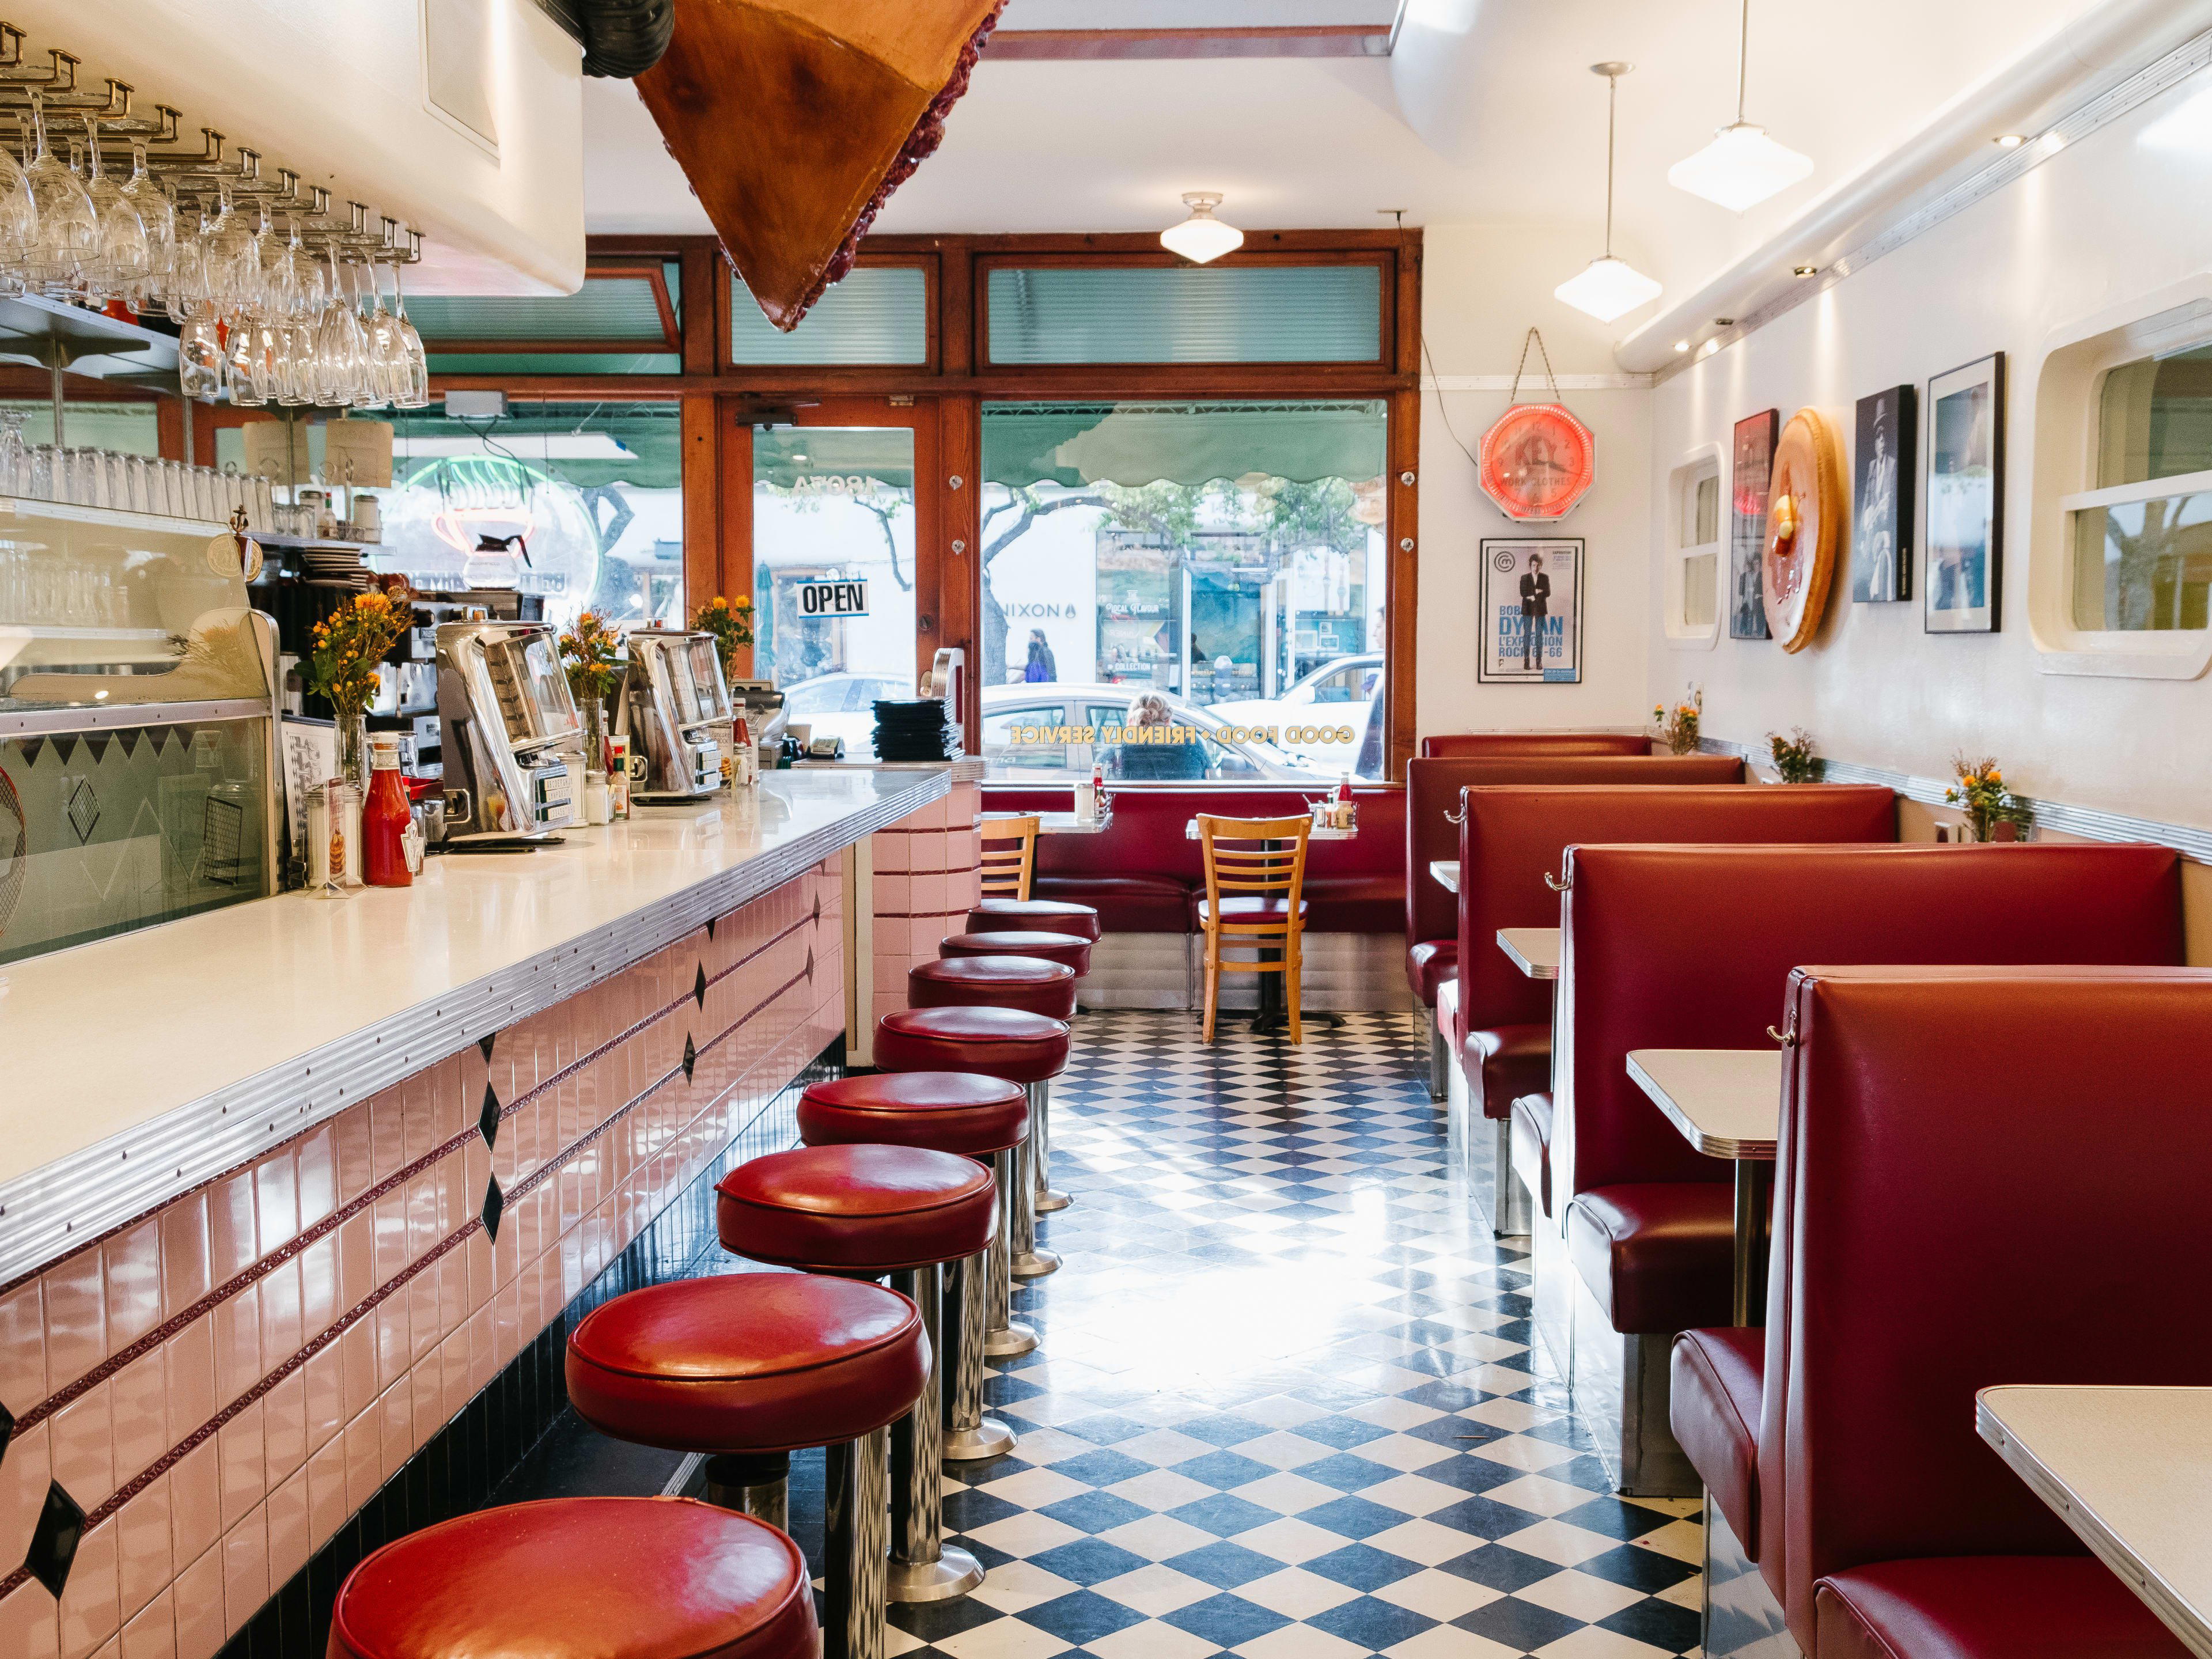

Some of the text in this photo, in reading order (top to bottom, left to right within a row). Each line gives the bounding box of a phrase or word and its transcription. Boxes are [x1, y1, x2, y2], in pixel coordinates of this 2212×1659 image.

[1515, 435, 1556, 465] KEY
[1501, 478, 1571, 486] WORK CLOTHES
[802, 584, 863, 613] OPEN
[1499, 605, 1521, 615] BOB
[1499, 616, 1563, 635] DYAN
[1499, 636, 1562, 646] L'EXPOION
[1532, 647, 1562, 657] 6-66
